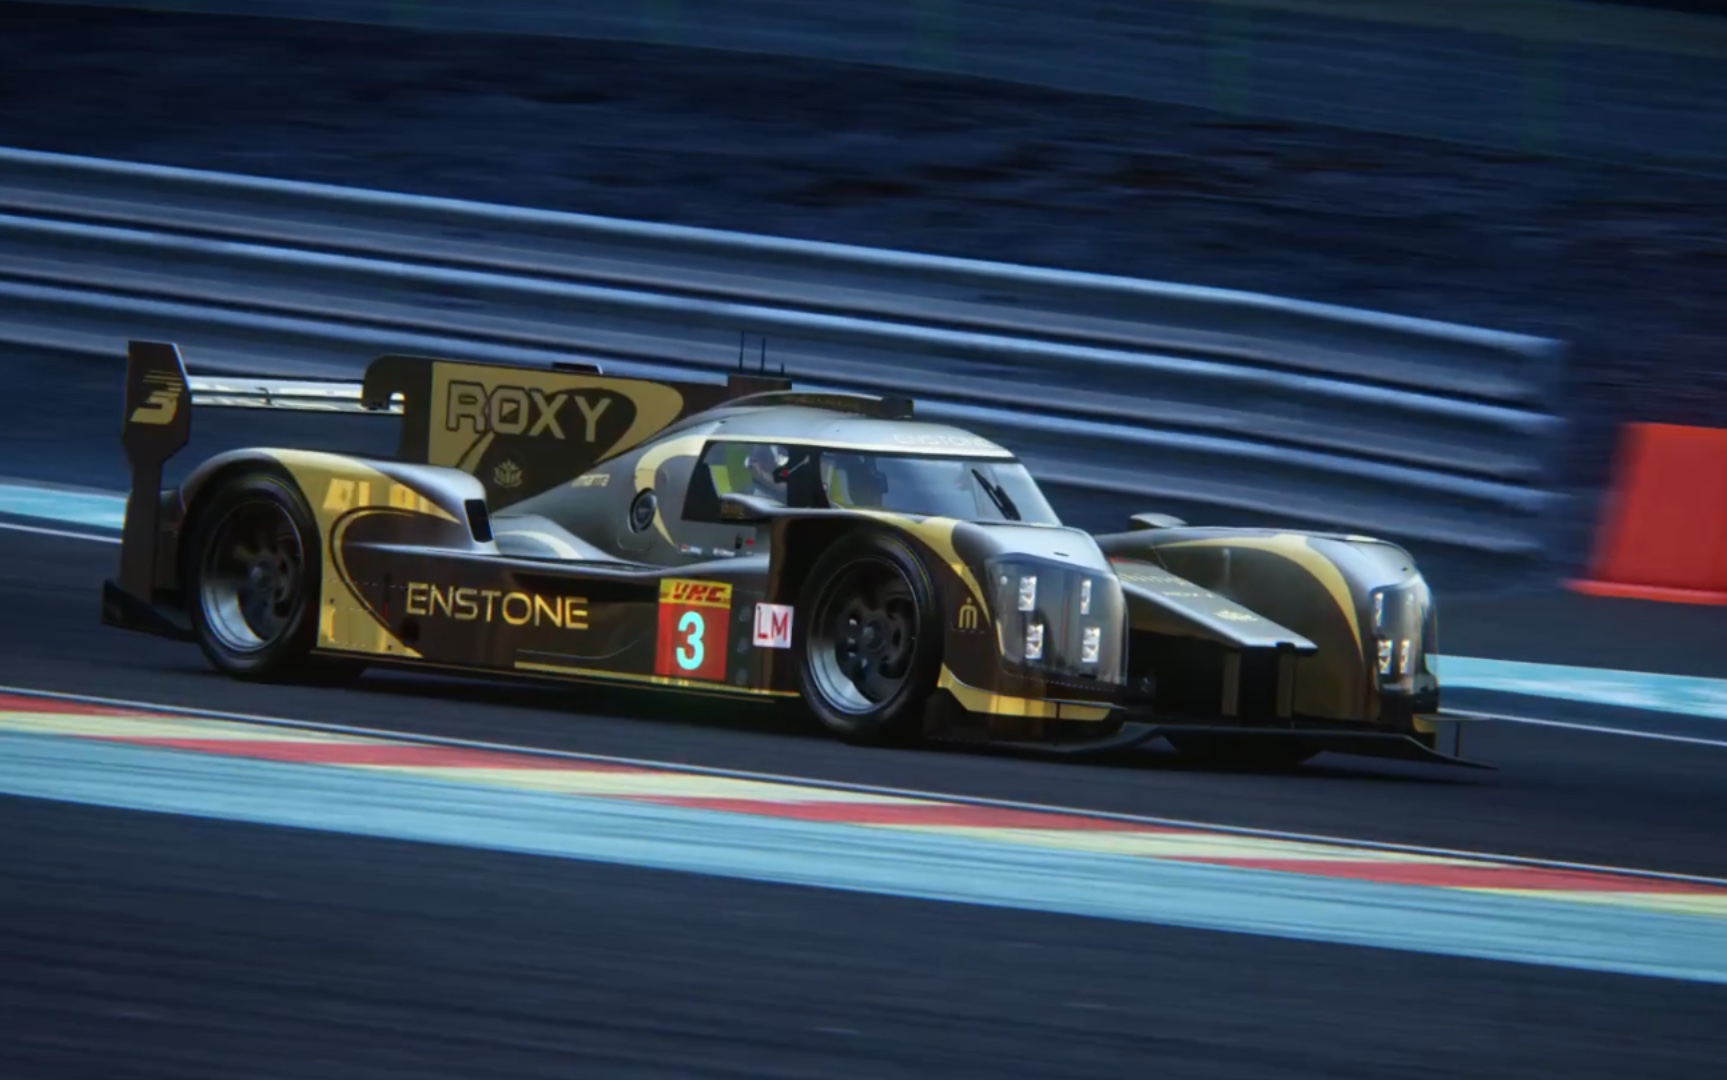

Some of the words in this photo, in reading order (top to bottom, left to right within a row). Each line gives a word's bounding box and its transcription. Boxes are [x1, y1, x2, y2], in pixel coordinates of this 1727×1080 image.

[446, 380, 611, 442] ROXY
[406, 582, 589, 630] ENSTONE
[757, 610, 789, 641] LM
[676, 611, 705, 671] 3
